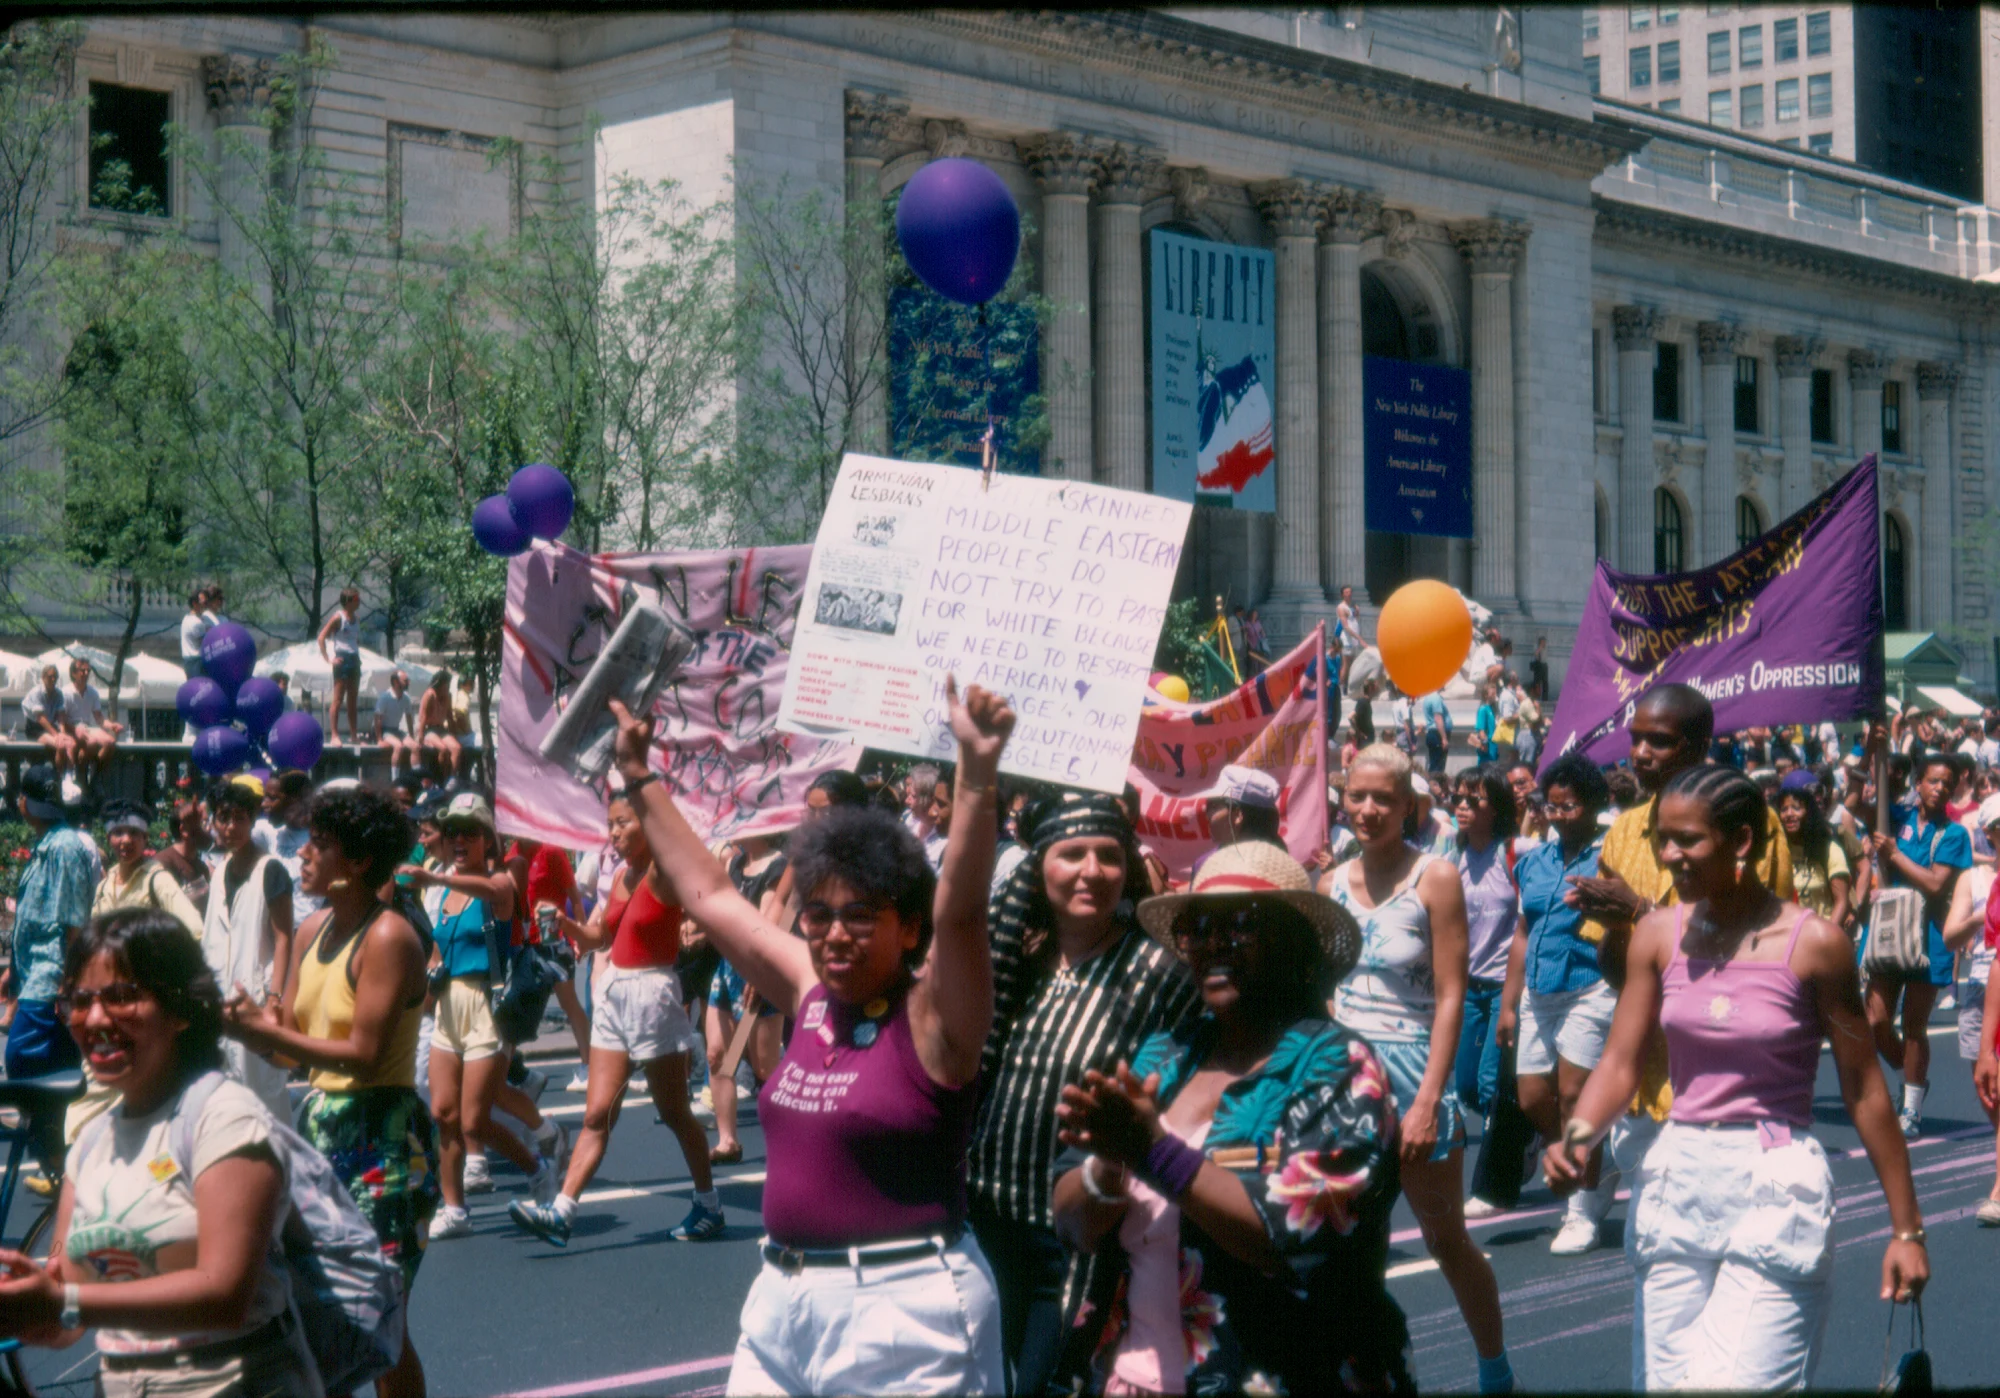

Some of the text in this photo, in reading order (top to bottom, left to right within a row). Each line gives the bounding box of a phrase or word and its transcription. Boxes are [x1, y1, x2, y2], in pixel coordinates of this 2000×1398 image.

[1164, 241, 1265, 325] LIBERTY
[850, 484, 923, 508] LESBIANS
[945, 505, 1182, 570] MIDDLE EASTERN
[937, 534, 1052, 573] PEOPLES
[1070, 558, 1105, 584] DO
[930, 568, 1168, 627] NOT TRY TO PASS
[1653, 580, 1706, 618] THE
[921, 597, 1156, 657] FOR WHITE BECAUSE
[716, 630, 777, 678] THE
[833, 656, 851, 666] WITH
[855, 660, 886, 672] TURKISH
[915, 629, 1153, 684] WE NEED TO RESPECT
[799, 675, 827, 686] TURKEY
[925, 653, 1068, 696] OUR AFRICAN
[1750, 659, 1861, 692] OPPRESSION
[884, 689, 920, 701] STRUGGLE
[793, 707, 834, 721] OPPRESSED
[848, 716, 861, 726] THE
[879, 708, 910, 720] VICTORY
[1084, 708, 1127, 733] OUR
[777, 1074, 848, 1098] but we can
[782, 1061, 859, 1086] I'm not easy
[770, 1089, 839, 1113] discuss it.
